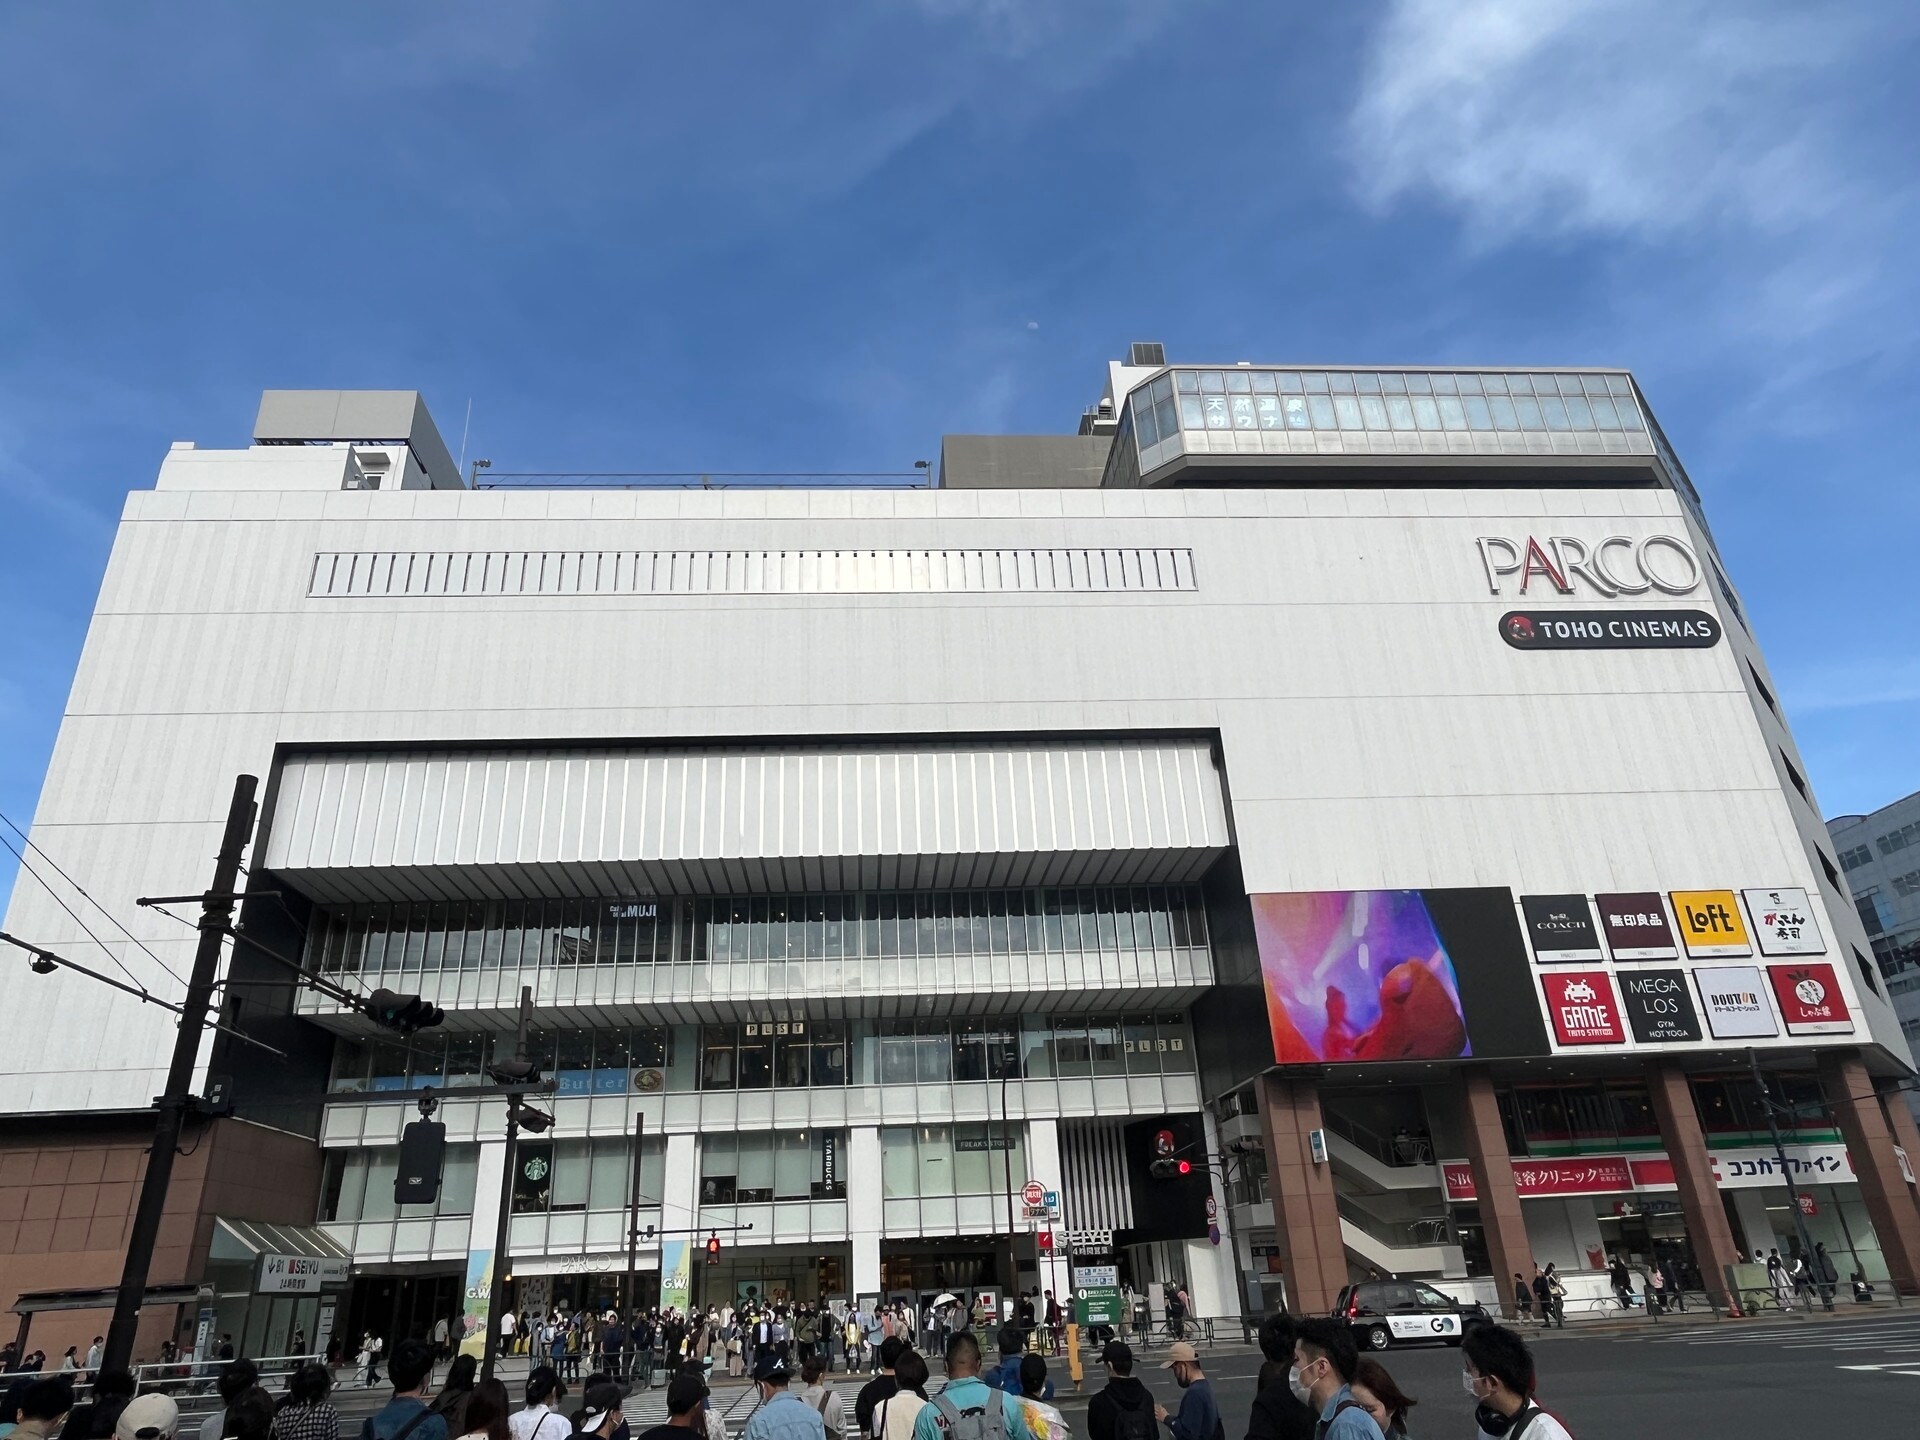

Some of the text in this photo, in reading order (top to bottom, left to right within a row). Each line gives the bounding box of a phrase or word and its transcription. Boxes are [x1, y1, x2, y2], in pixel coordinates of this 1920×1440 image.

[1207, 398, 1302, 412] 天然温泉
[1211, 415, 1278, 427] サウナ
[1475, 534, 1702, 597] PARCO
[1539, 620, 1712, 638] TOHO CINEMAS
[627, 904, 657, 917] MUJI
[1536, 921, 1587, 930] COACH
[1609, 912, 1663, 927] 無印良品
[1763, 912, 1806, 927] がってん
[1774, 927, 1801, 940] 寿司
[1629, 978, 1682, 994] MEGA
[1643, 998, 1679, 1014] LOS
[1711, 992, 1759, 1006] DOUTOR
[1561, 1005, 1611, 1029] GAME
[1800, 1005, 1832, 1018] しゃぶ葉
[748, 1023, 802, 1035] PLST
[1657, 1020, 1676, 1028] GYM
[1566, 1028, 1614, 1037] TAITO STATION
[1649, 1029, 1689, 1038] HOT YOGA
[1124, 1039, 1182, 1051] PLST
[825, 1138, 833, 1191] STARBUCKS
[1055, 1230, 1112, 1248] SEIYU
[1072, 1247, 1109, 1255] 4時間営業
[276, 1259, 320, 1275] B1 SEIYU
[558, 1254, 612, 1273] PARCO
[1430, 1317, 1454, 1333] GO
